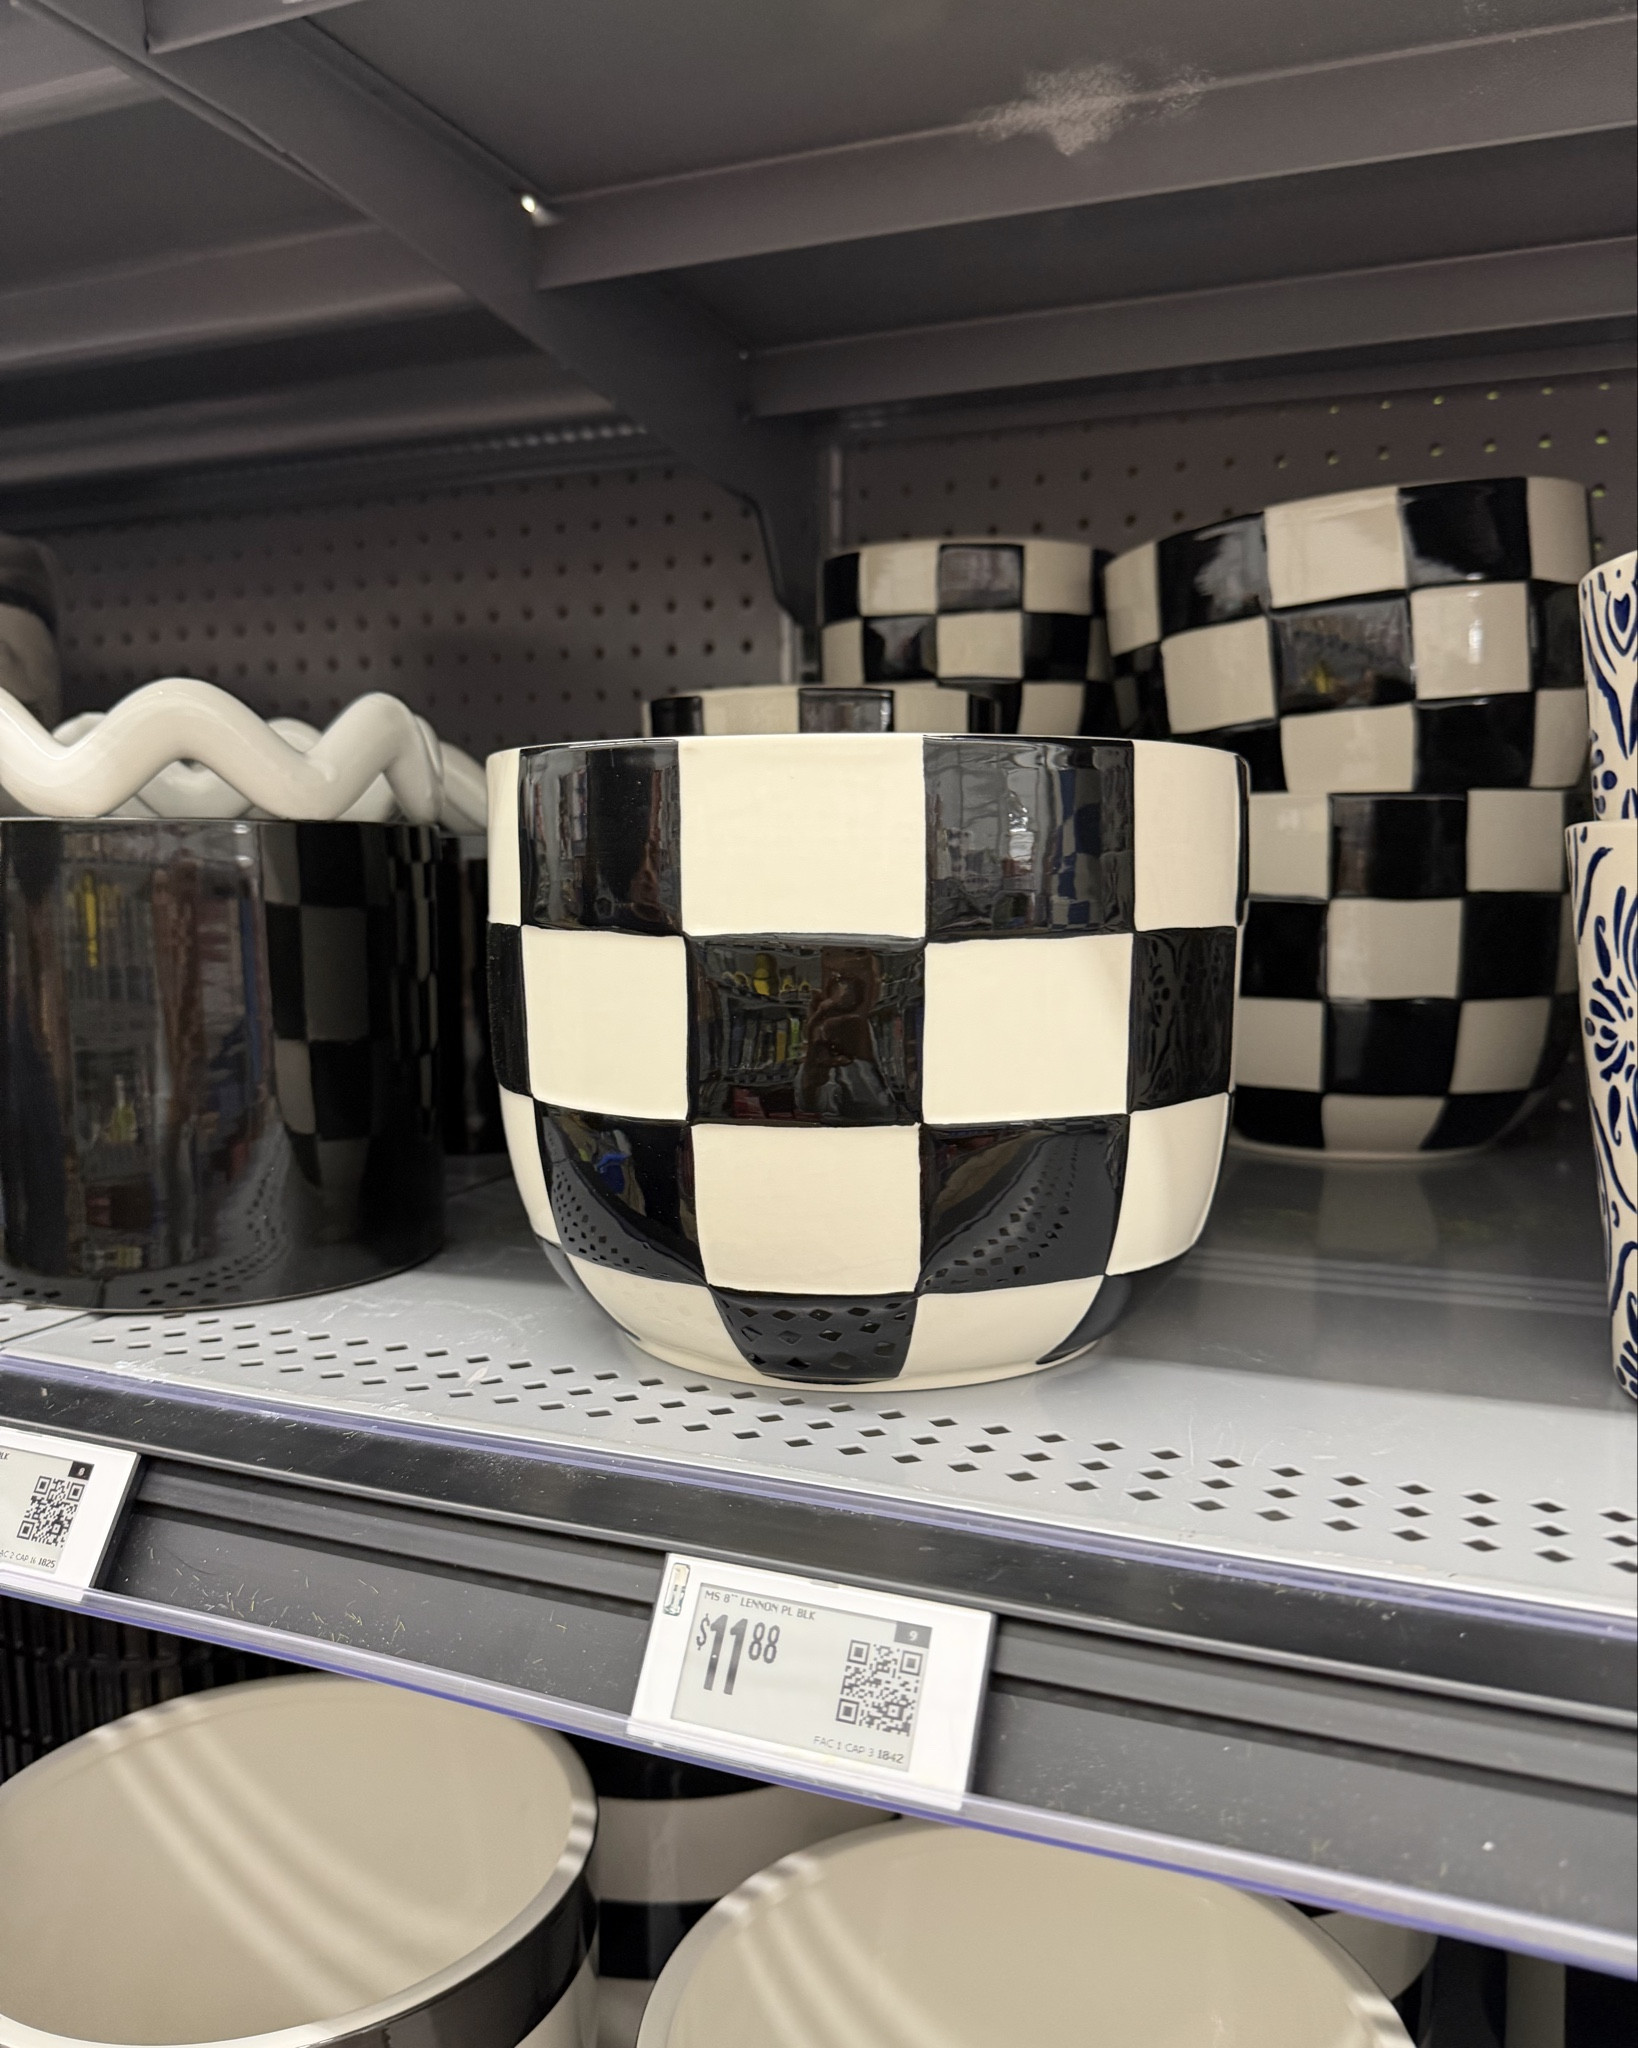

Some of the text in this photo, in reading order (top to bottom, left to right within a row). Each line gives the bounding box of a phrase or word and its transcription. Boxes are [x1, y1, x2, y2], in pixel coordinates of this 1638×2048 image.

[9, 1551, 15, 1560] 2
[15, 1553, 29, 1562] CAP
[38, 1557, 56, 1569] 1825
[705, 1590, 720, 1601] MS
[740, 1597, 778, 1612] LENNON
[781, 1605, 793, 1616] PL
[796, 1609, 817, 1621] BLK
[908, 1630, 919, 1642] 9
[813, 1735, 905, 1764] FAC 1 CAP 3 1842
